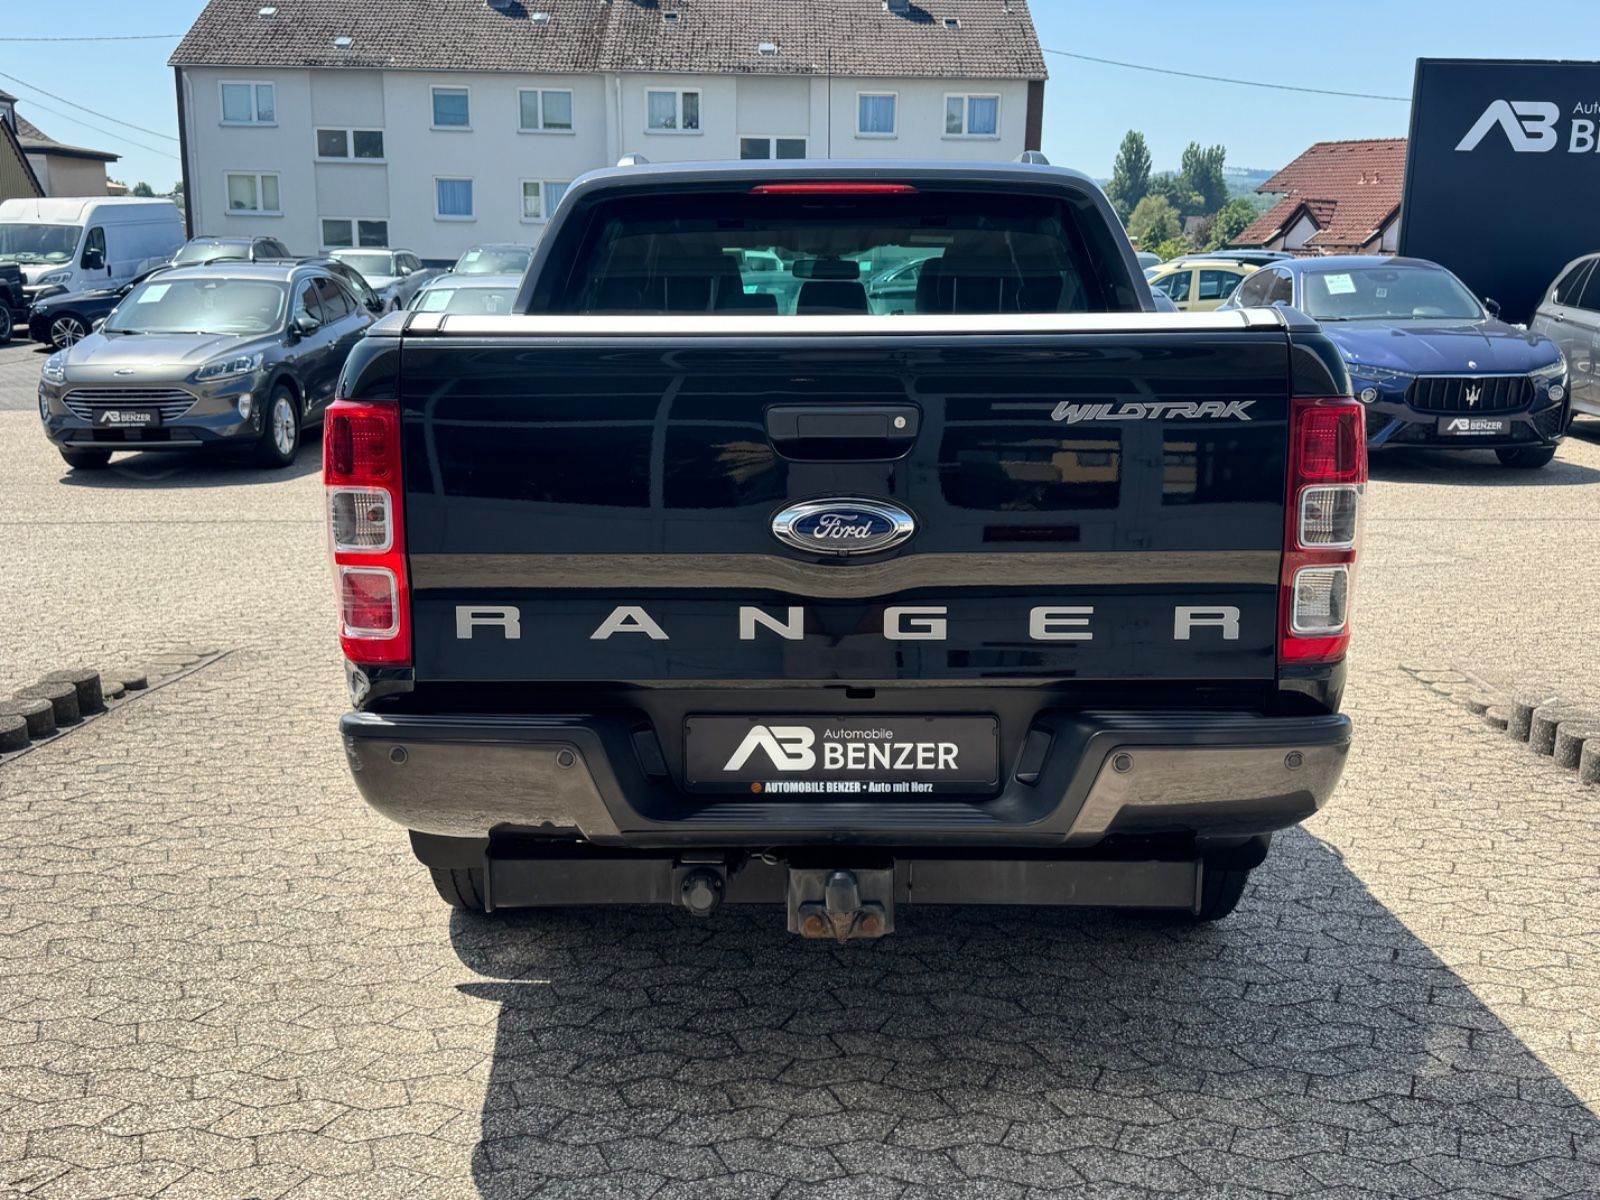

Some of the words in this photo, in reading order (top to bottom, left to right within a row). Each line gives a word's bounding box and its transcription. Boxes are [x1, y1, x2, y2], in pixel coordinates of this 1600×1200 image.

[1572, 101, 1600, 114] Aut
[1567, 119, 1600, 153] B
[121, 413, 151, 422] BENZER
[1051, 400, 1256, 424] WILDTRAK
[1470, 421, 1503, 430] BENZER
[813, 513, 874, 539] Ford
[456, 605, 1240, 640] RANGER
[823, 728, 894, 739] Automobile
[823, 742, 959, 770] BENZER
[765, 781, 825, 793] AUTOMOBILE
[826, 781, 861, 793] BENZER
[868, 782, 891, 793] Auto
[893, 782, 910, 793] mit
